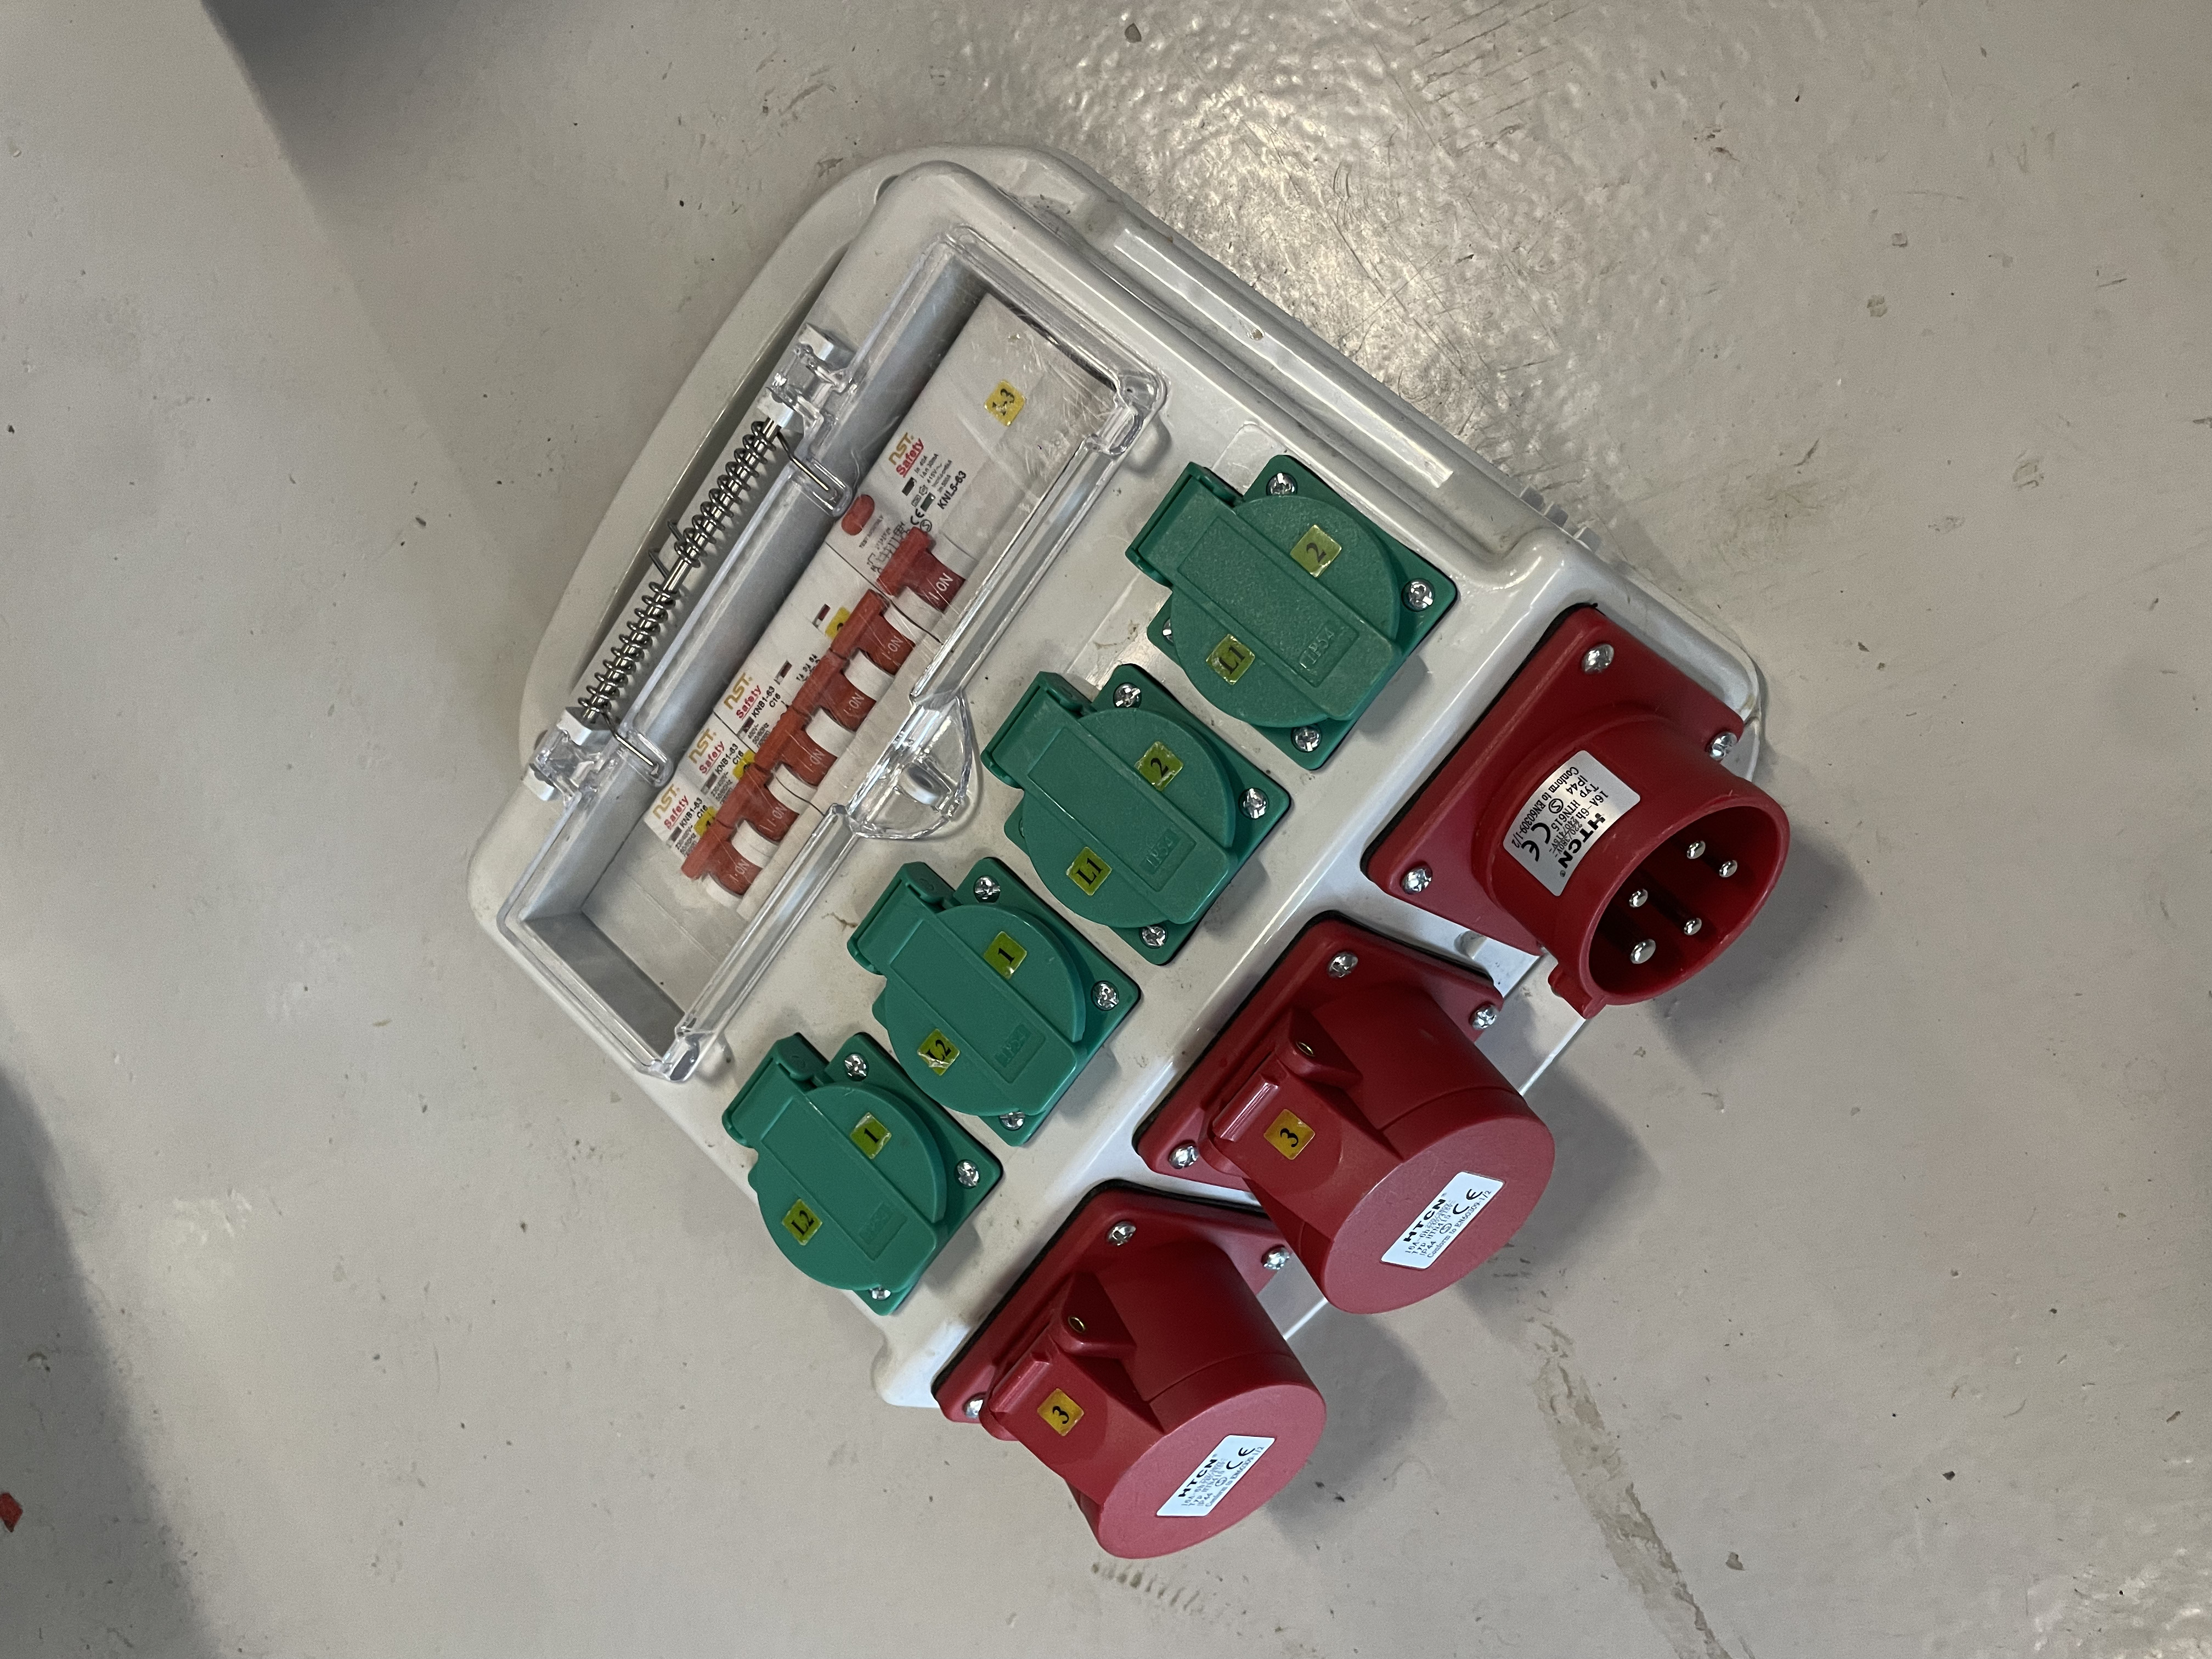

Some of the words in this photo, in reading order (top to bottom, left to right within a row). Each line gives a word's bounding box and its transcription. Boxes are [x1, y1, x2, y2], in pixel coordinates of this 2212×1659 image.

[895, 437, 927, 476] Safety
[1303, 540, 1327, 563] 2
[1302, 625, 1336, 664] IP54
[1216, 644, 1246, 675] L1
[735, 684, 763, 719] Safety
[751, 685, 776, 718] KNB1-63
[768, 692, 781, 708] C16
[698, 740, 727, 775] Safety
[714, 742, 738, 775] KNB1-63
[1147, 756, 1170, 777] 2
[1548, 765, 1580, 793] Conform
[1565, 775, 1588, 795] IP44
[1578, 781, 1599, 799] Typ
[1541, 792, 1551, 802] to
[1575, 789, 1609, 821] 16A-6h
[663, 794, 691, 830] Safety
[1510, 799, 1545, 848] EN60309-1/2
[1550, 799, 1581, 832] HTN615
[1520, 821, 1550, 861] CE
[1074, 857, 1103, 886] L1
[996, 946, 1015, 964] 1
[925, 1037, 952, 1065] L2
[861, 1127, 881, 1144] 1
[1279, 1127, 1299, 1148] 3
[1453, 1189, 1482, 1215] CE
[789, 1208, 816, 1237] L2
[1419, 1241, 1436, 1256] IP44
[1427, 1235, 1451, 1258] Conform
[1052, 1405, 1070, 1424] 3
[1227, 1447, 1255, 1470] CE
